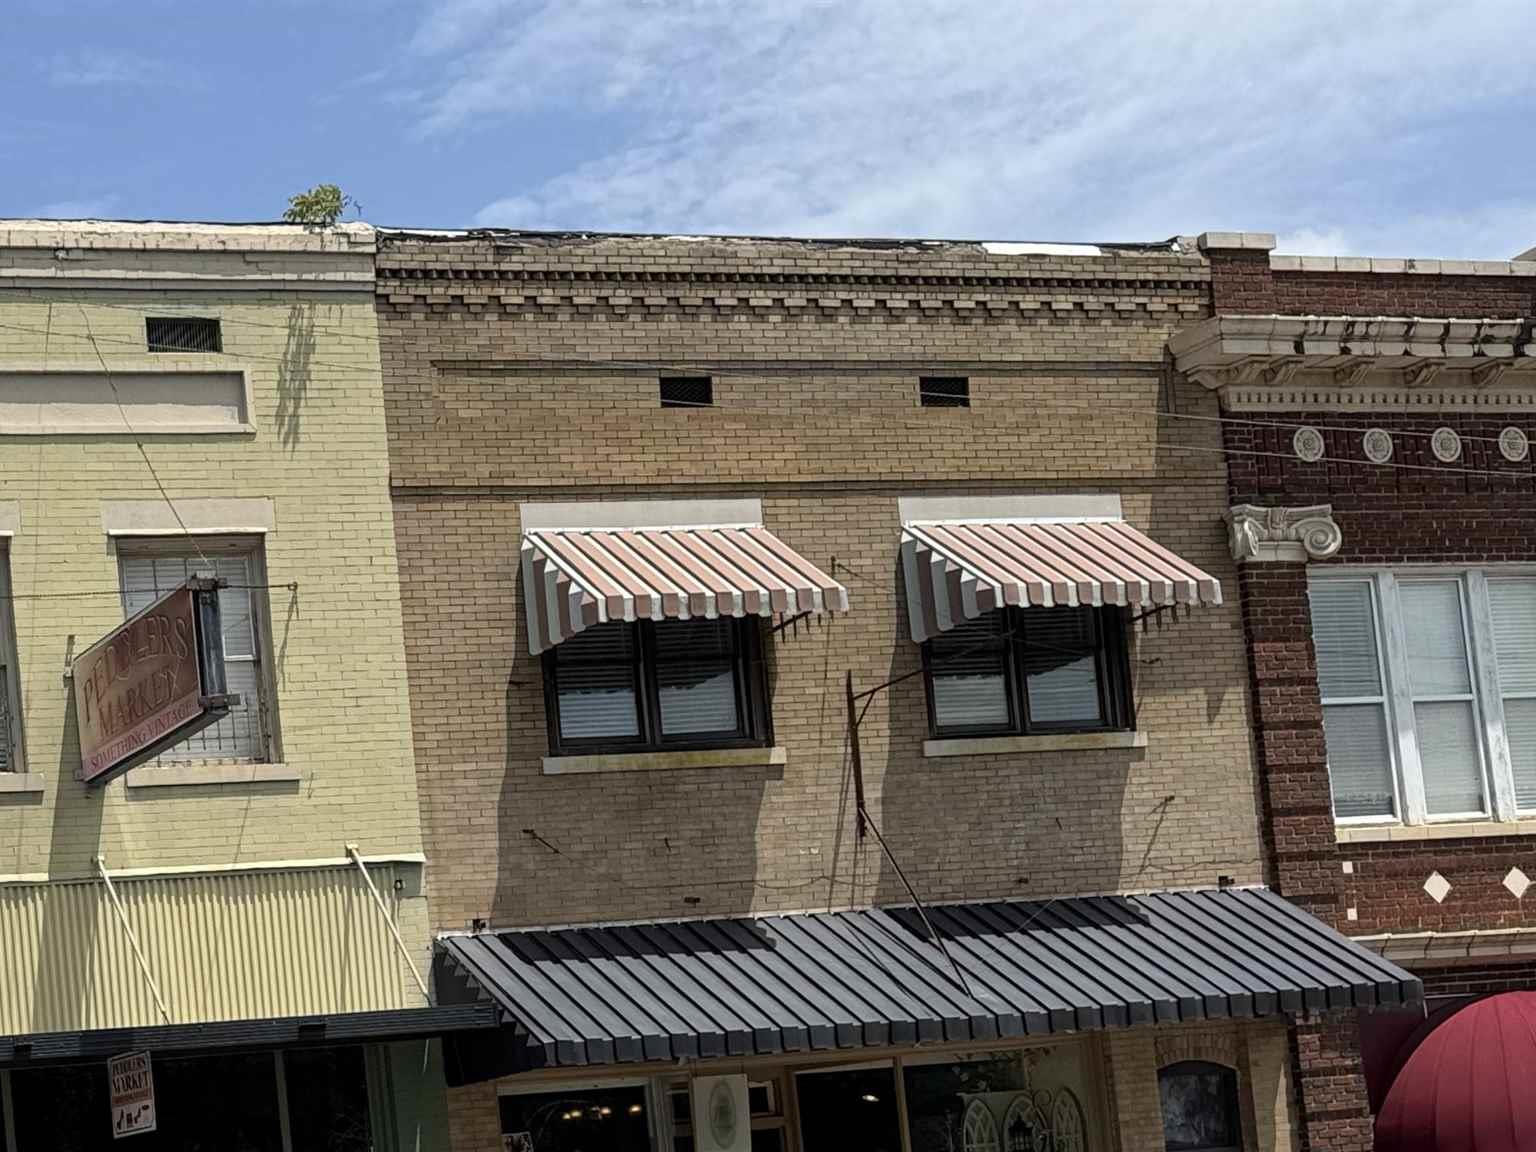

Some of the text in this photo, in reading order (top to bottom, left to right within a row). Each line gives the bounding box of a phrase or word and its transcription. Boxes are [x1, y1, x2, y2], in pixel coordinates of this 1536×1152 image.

[91, 702, 199, 770] SOMETHING VINTAGE
[98, 664, 178, 740] MARKET
